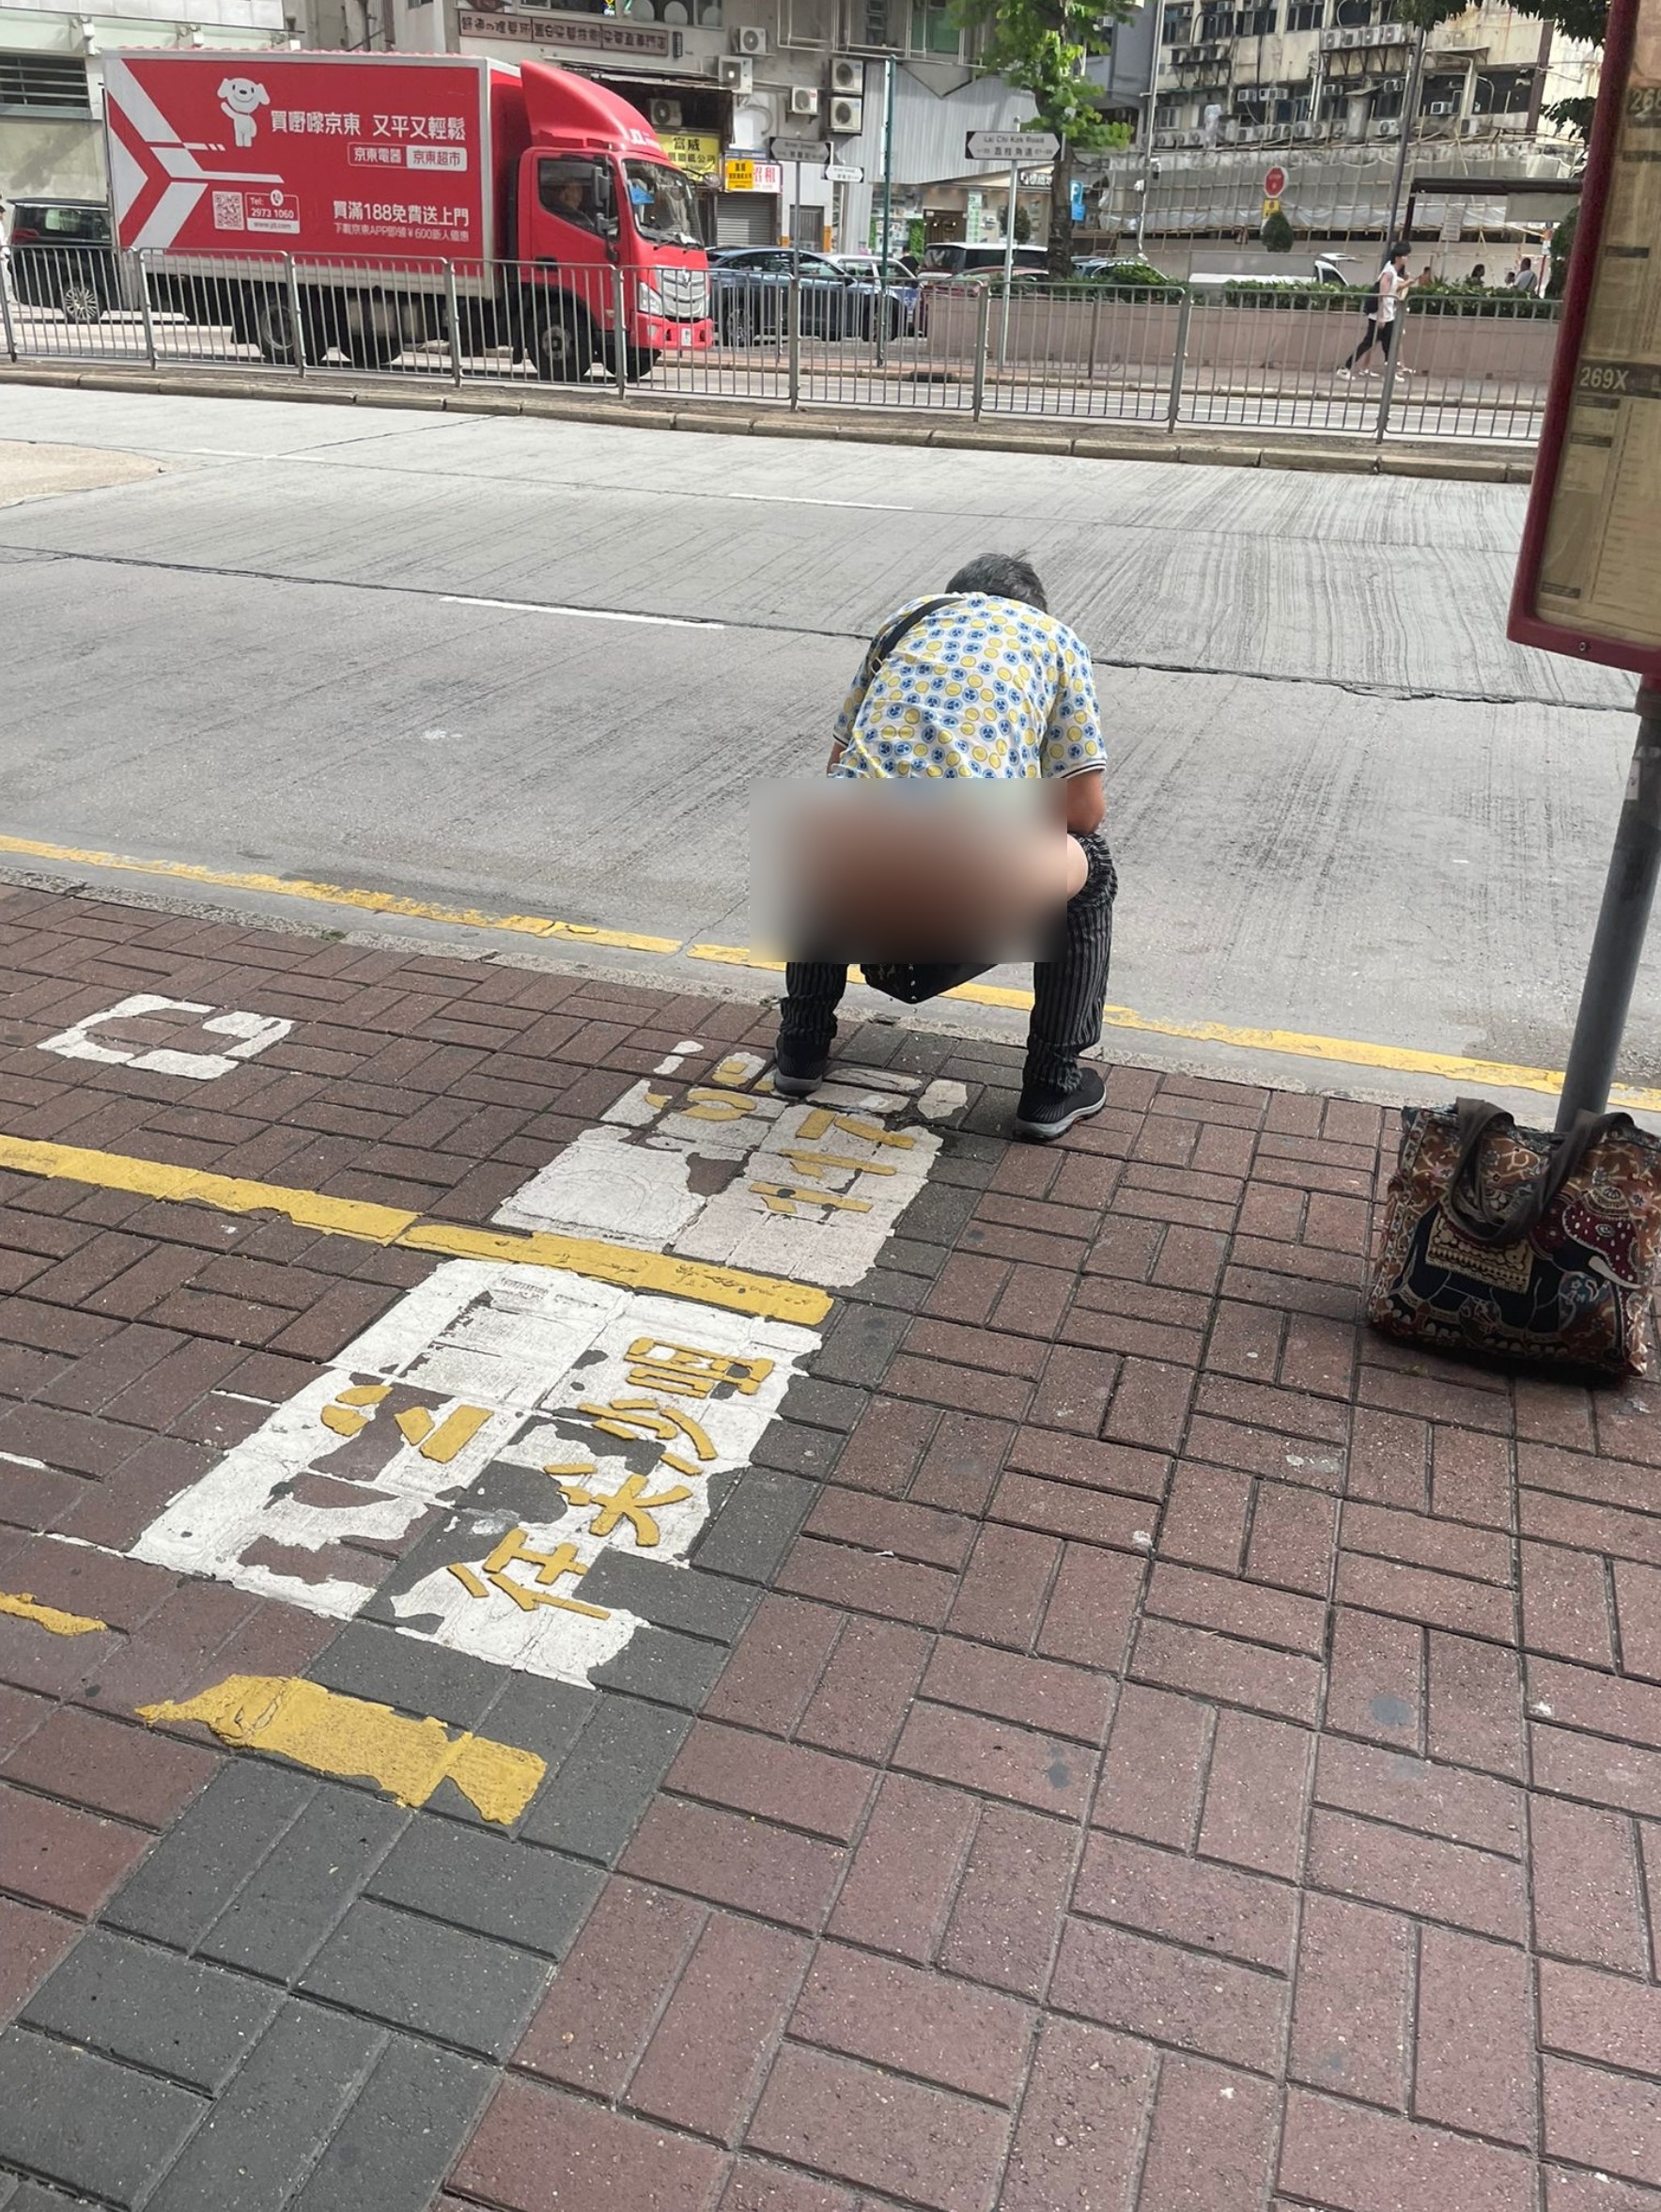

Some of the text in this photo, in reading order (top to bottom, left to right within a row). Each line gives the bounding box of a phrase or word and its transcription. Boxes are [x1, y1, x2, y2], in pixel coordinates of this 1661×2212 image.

[271, 109, 467, 141] 買嘢嚟京東 又平又輕鬆
[412, 150, 460, 166] 京東超市
[249, 197, 264, 206] Tel:
[251, 208, 295, 219] 2973 1060
[334, 200, 469, 226] 買滿188免費送上門
[1579, 366, 1630, 391] 269X
